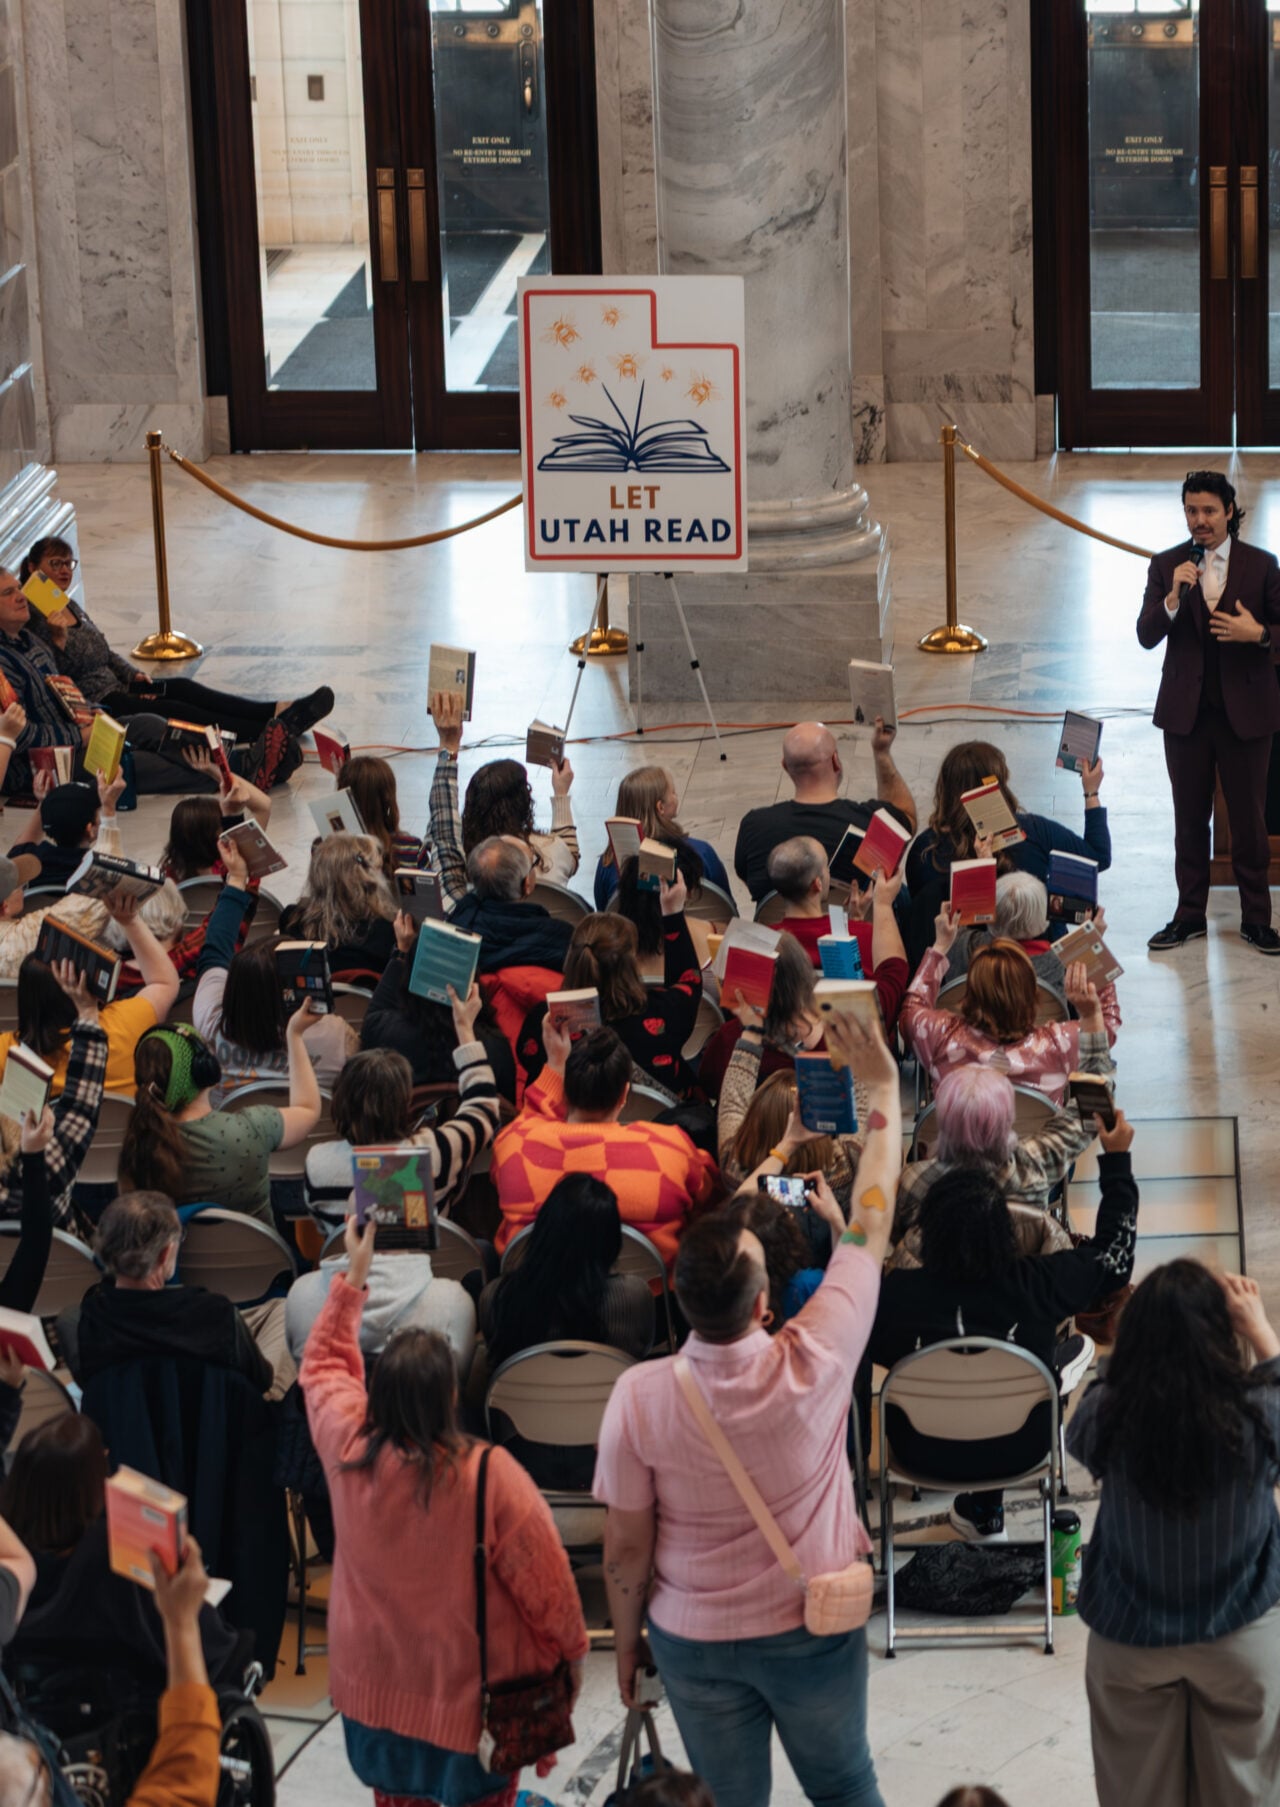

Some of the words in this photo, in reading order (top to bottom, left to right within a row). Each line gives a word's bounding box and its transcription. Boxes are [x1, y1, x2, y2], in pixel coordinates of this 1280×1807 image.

[610, 485, 661, 510] LET
[540, 518, 629, 543] UTAH
[644, 518, 732, 543] READ
